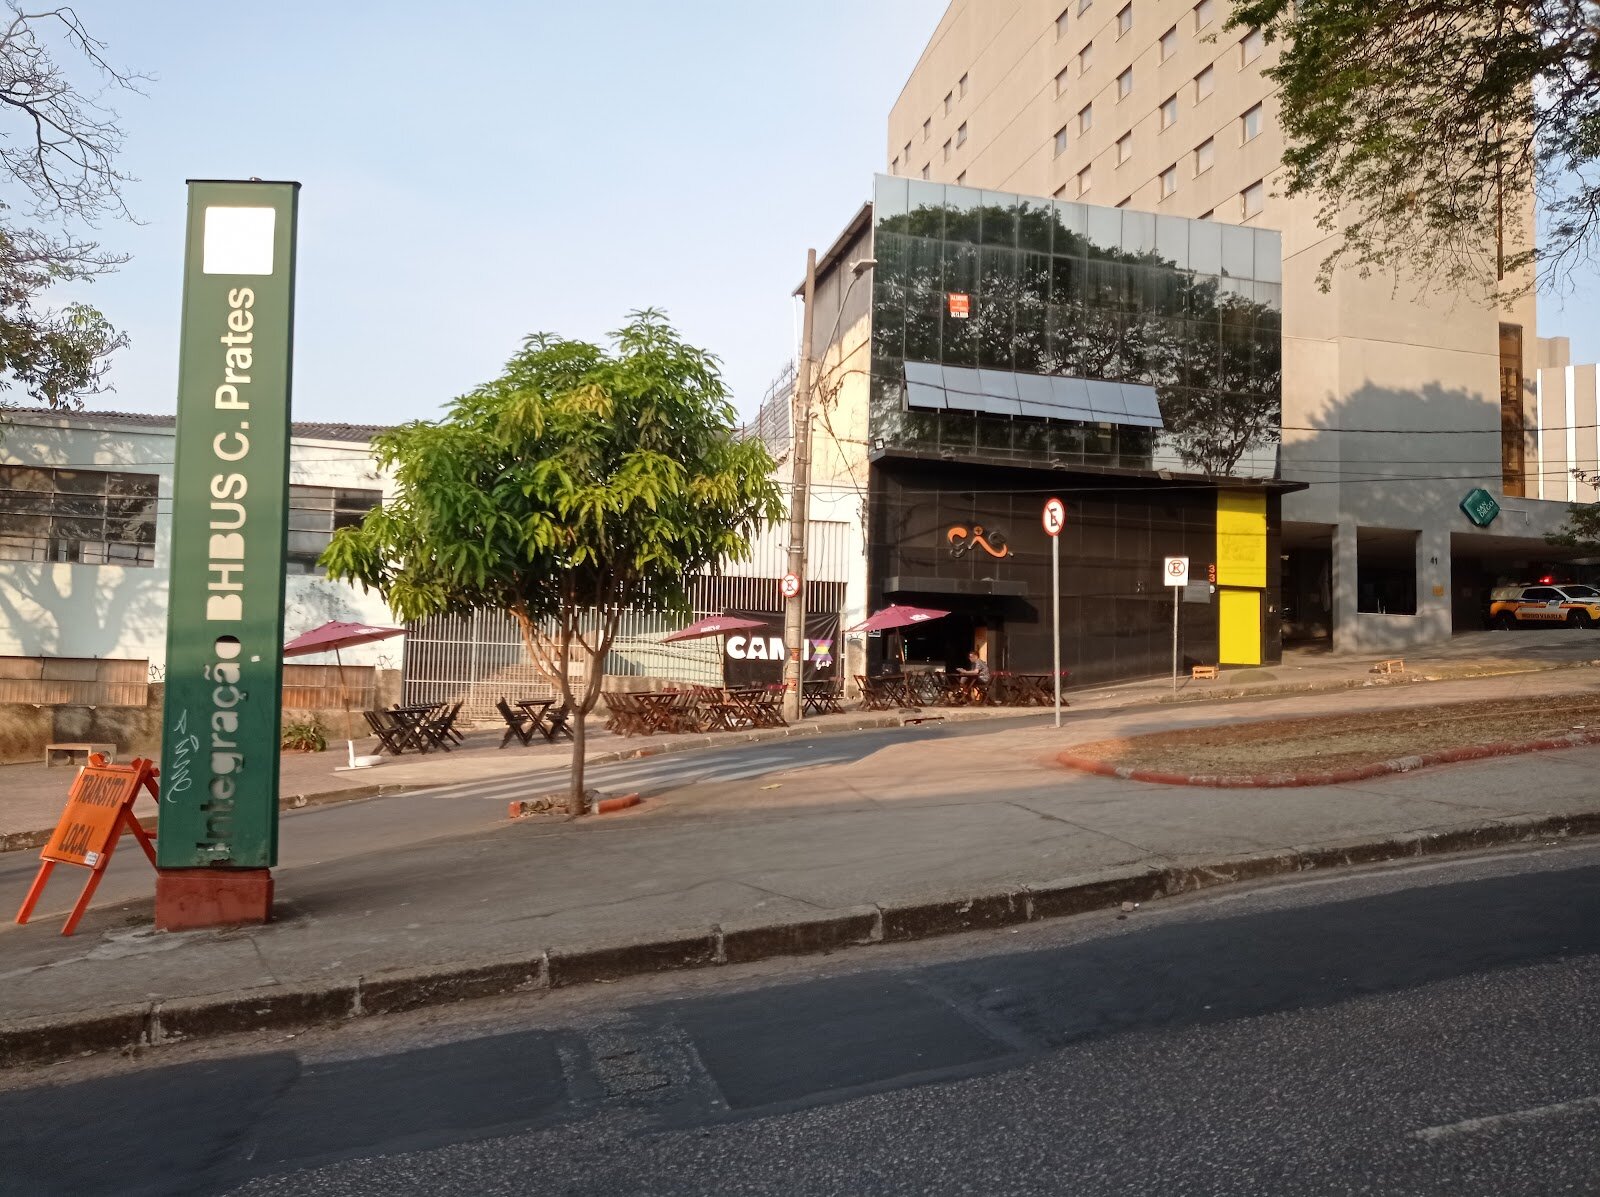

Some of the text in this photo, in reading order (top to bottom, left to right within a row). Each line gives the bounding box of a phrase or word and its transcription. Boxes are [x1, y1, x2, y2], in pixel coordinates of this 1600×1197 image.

[214, 287, 255, 410] Prates
[212, 421, 251, 462] C.
[206, 473, 248, 621] BHBUS
[58, 822, 95, 856] LOCAL
